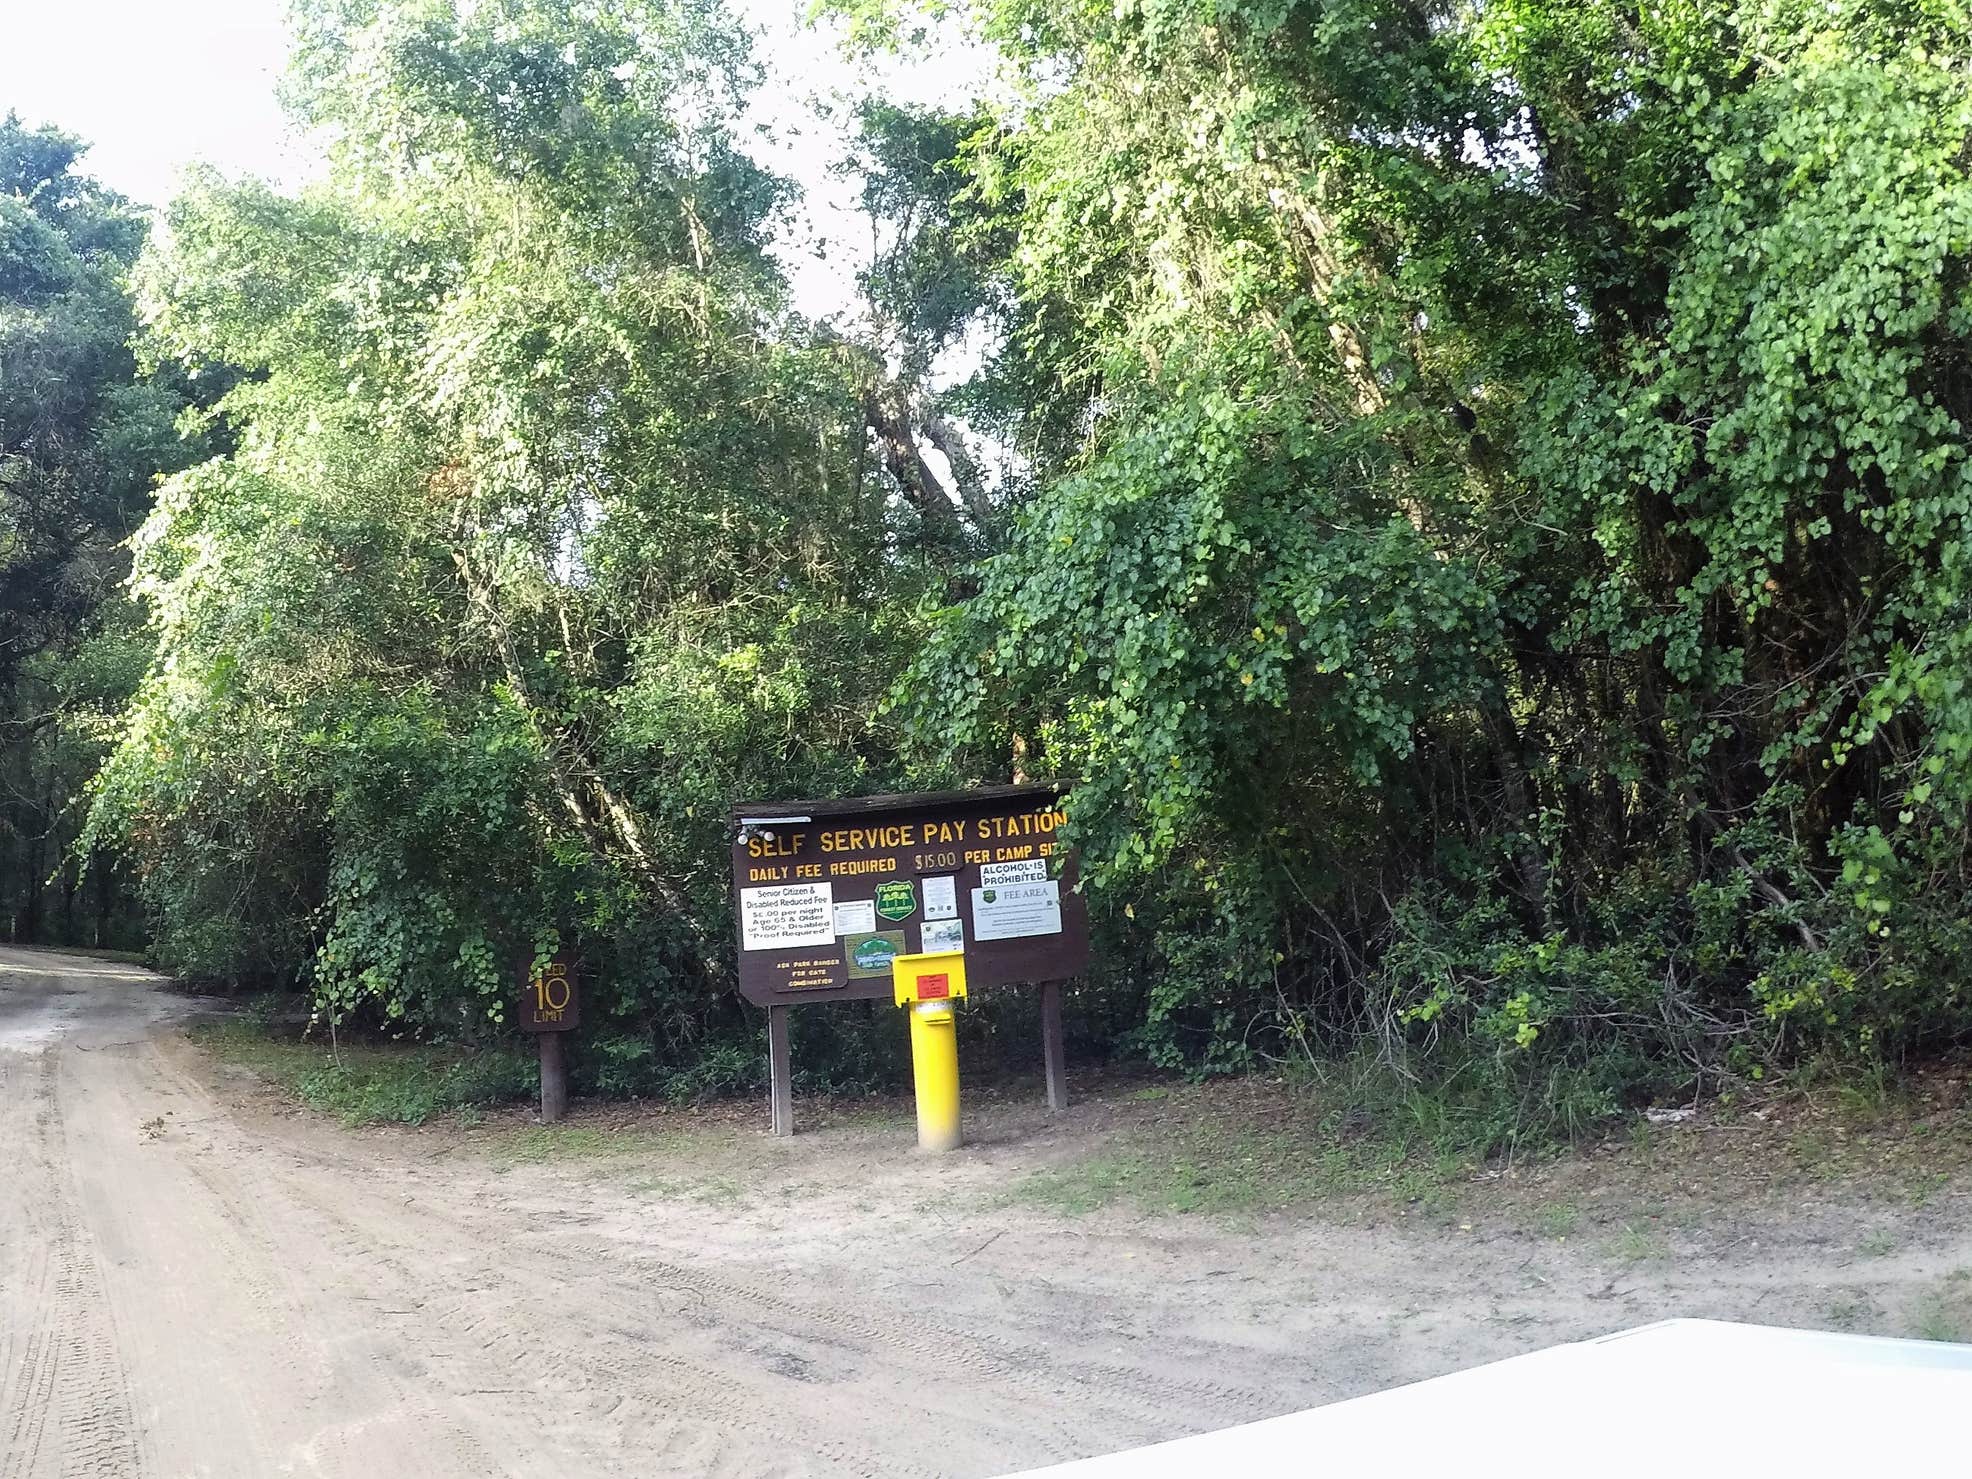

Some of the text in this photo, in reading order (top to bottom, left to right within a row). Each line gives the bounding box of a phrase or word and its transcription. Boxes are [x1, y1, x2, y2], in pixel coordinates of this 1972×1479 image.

[748, 809, 1068, 858] SELF SERVICE PAY STATION
[749, 841, 1069, 882] DAILY FEE REQUIRED $15.00 PER CAMP SI
[983, 861, 1044, 875] ALCOHOL IS
[757, 890, 781, 898] Senior
[782, 887, 809, 896] Citizen
[1003, 888, 1048, 900] FEE AREA
[746, 896, 828, 909] Disabled Reduced Fee
[799, 907, 823, 916] night
[752, 918, 771, 927] Age
[798, 914, 824, 922] Older
[788, 920, 830, 930] Disabled
[535, 977, 570, 1010] 10
[533, 1008, 565, 1023] LIMIT
